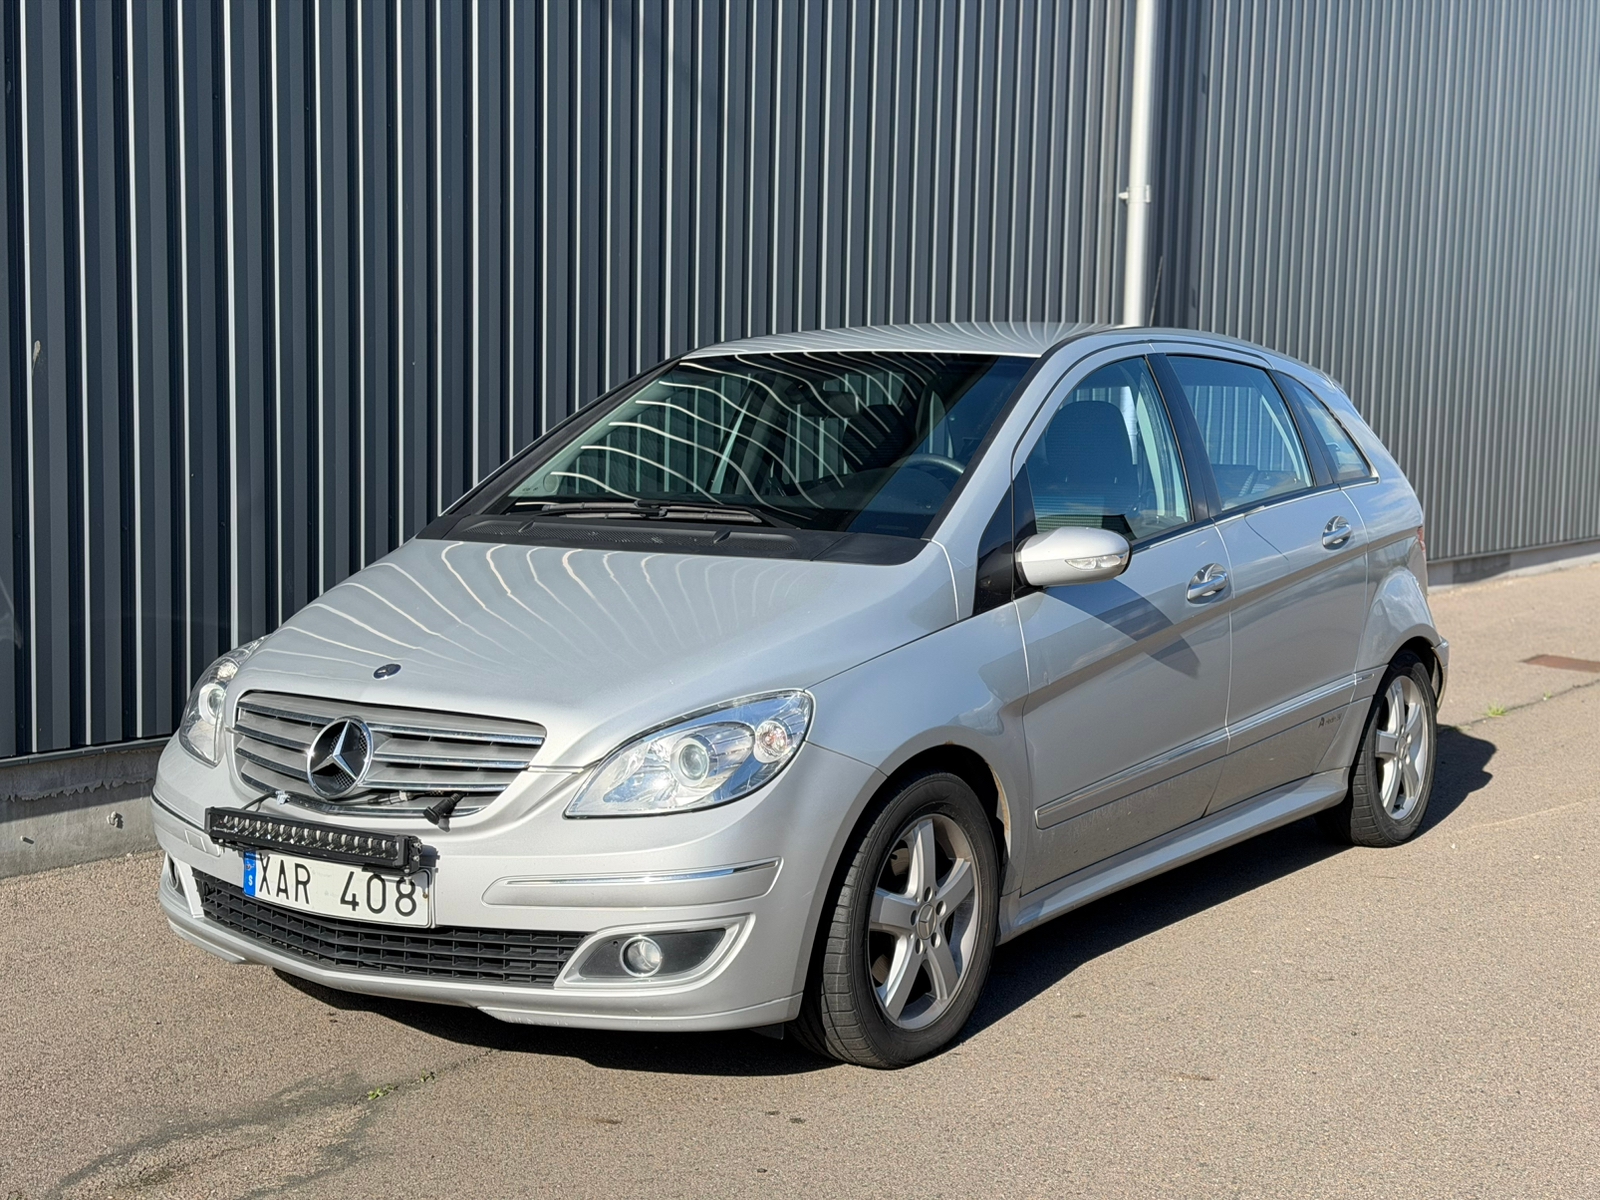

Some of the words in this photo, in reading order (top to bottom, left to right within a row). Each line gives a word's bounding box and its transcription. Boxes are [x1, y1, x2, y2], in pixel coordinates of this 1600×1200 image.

[248, 874, 253, 886] S
[258, 853, 311, 904] XAR
[340, 871, 417, 917] 408
